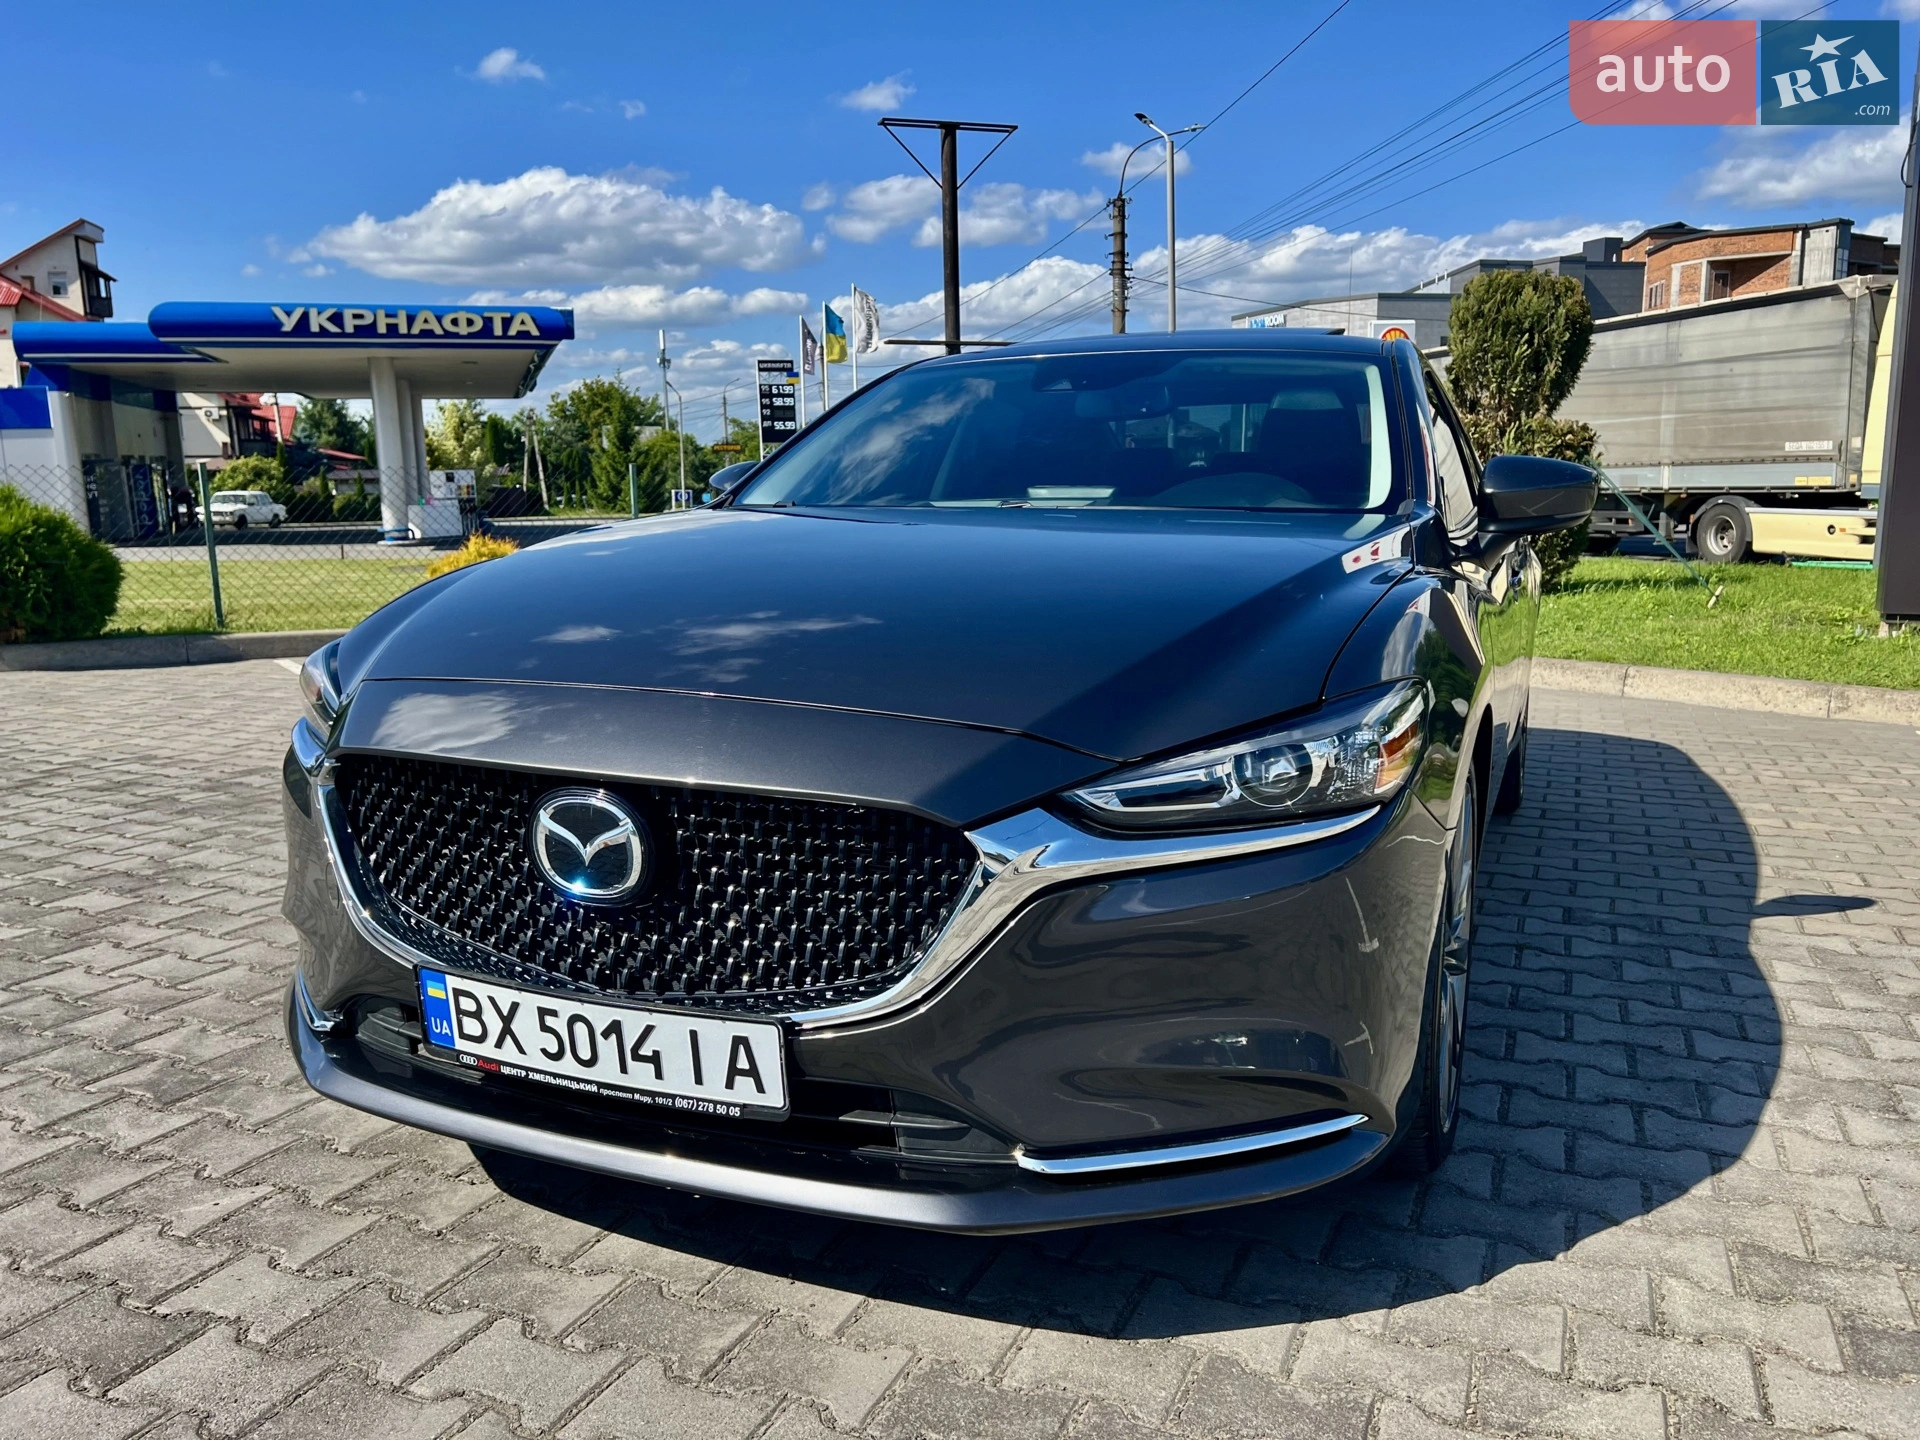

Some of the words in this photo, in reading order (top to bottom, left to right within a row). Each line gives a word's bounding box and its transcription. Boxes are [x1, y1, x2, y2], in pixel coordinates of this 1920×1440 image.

[270, 305, 541, 337] УКРНАФТА
[772, 385, 794, 394] 61.99
[773, 397, 795, 406] 58.99
[774, 421, 796, 430] 55.99
[431, 1017, 451, 1037] UA
[451, 987, 527, 1056] BX
[536, 1005, 664, 1081] 5014
[687, 1029, 766, 1094] IA
[477, 1059, 499, 1072] Audi
[500, 1064, 527, 1078] ЦЕНТР
[528, 1071, 598, 1093] ХМЕЛЬНИЦЬКИЙ
[599, 1087, 633, 1100] проспект
[633, 1092, 654, 1104] Миру,
[654, 1096, 673, 1106] 101/2
[675, 1096, 697, 1111] (067)
[698, 1101, 714, 1113] 278
[716, 1104, 727, 1115] 50
[728, 1106, 740, 1117] 05
